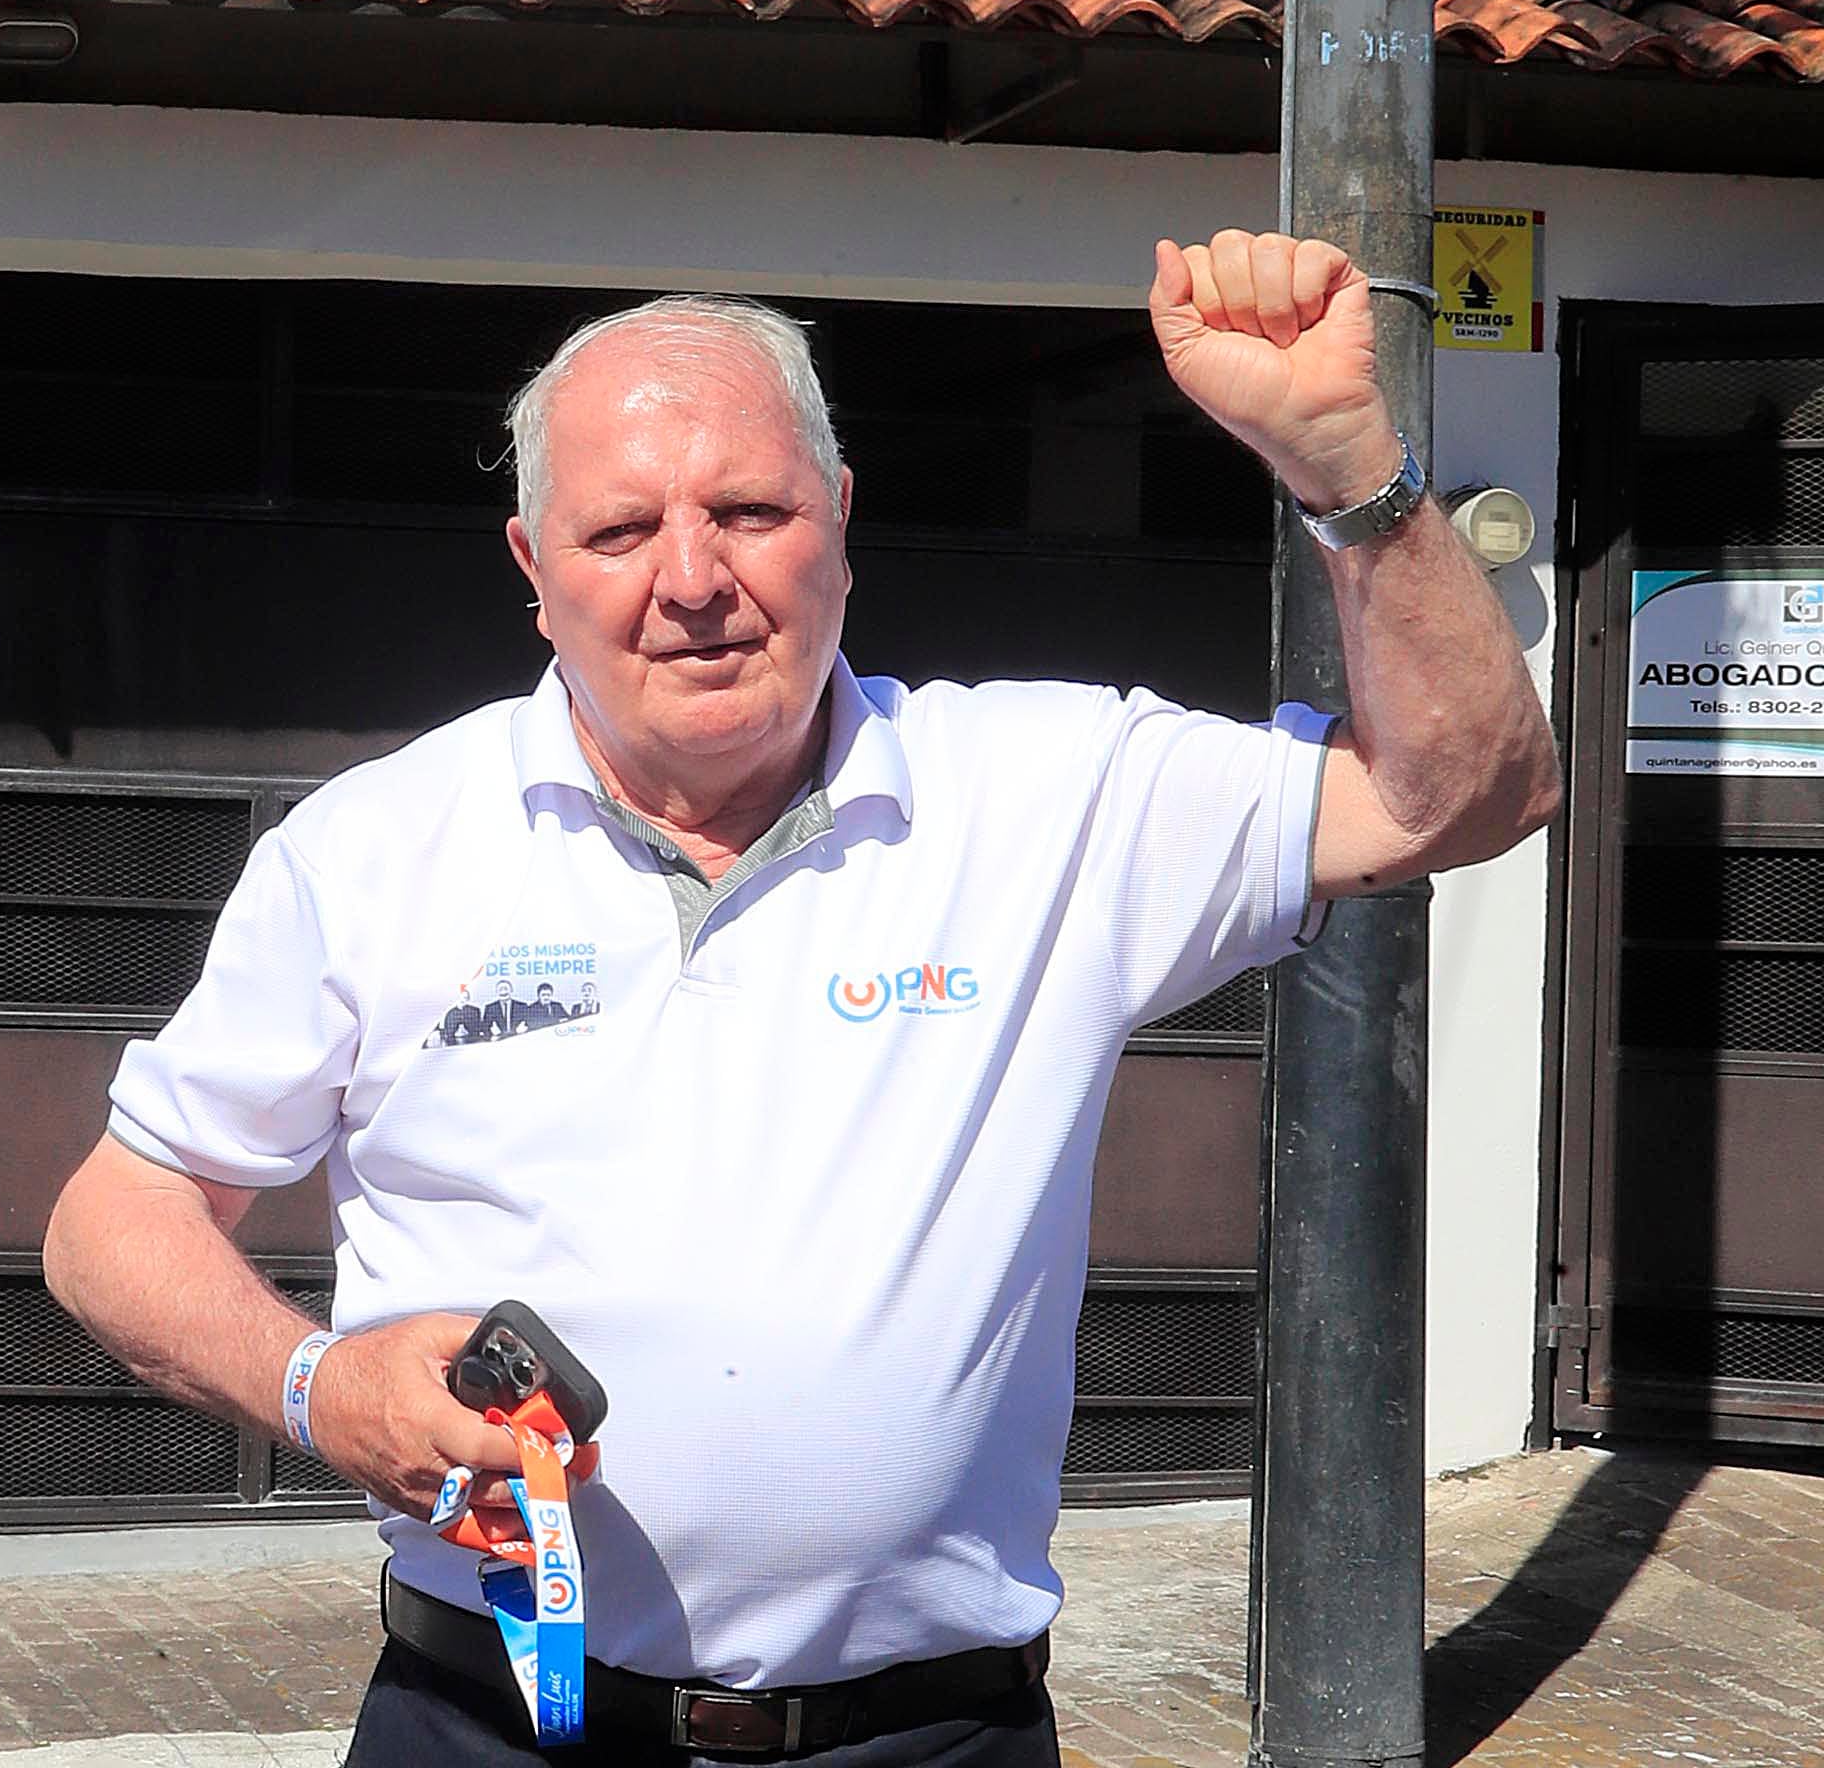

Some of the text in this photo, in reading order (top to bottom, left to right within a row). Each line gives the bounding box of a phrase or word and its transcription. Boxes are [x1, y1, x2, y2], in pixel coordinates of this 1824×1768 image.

[1434, 210, 1527, 227] SEGURIDAD
[1442, 312, 1514, 327] VECINOS
[1704, 641, 1734, 656] Lic.
[1740, 639, 1802, 656] Geiner
[1690, 699, 1824, 714] Tels.: 8302-2
[1646, 756, 1817, 770] quintanageiner@yahoo.es
[500, 945, 530, 958] LOS
[534, 942, 597, 957] MISMOS
[486, 958, 597, 977] DE SIEMPRE
